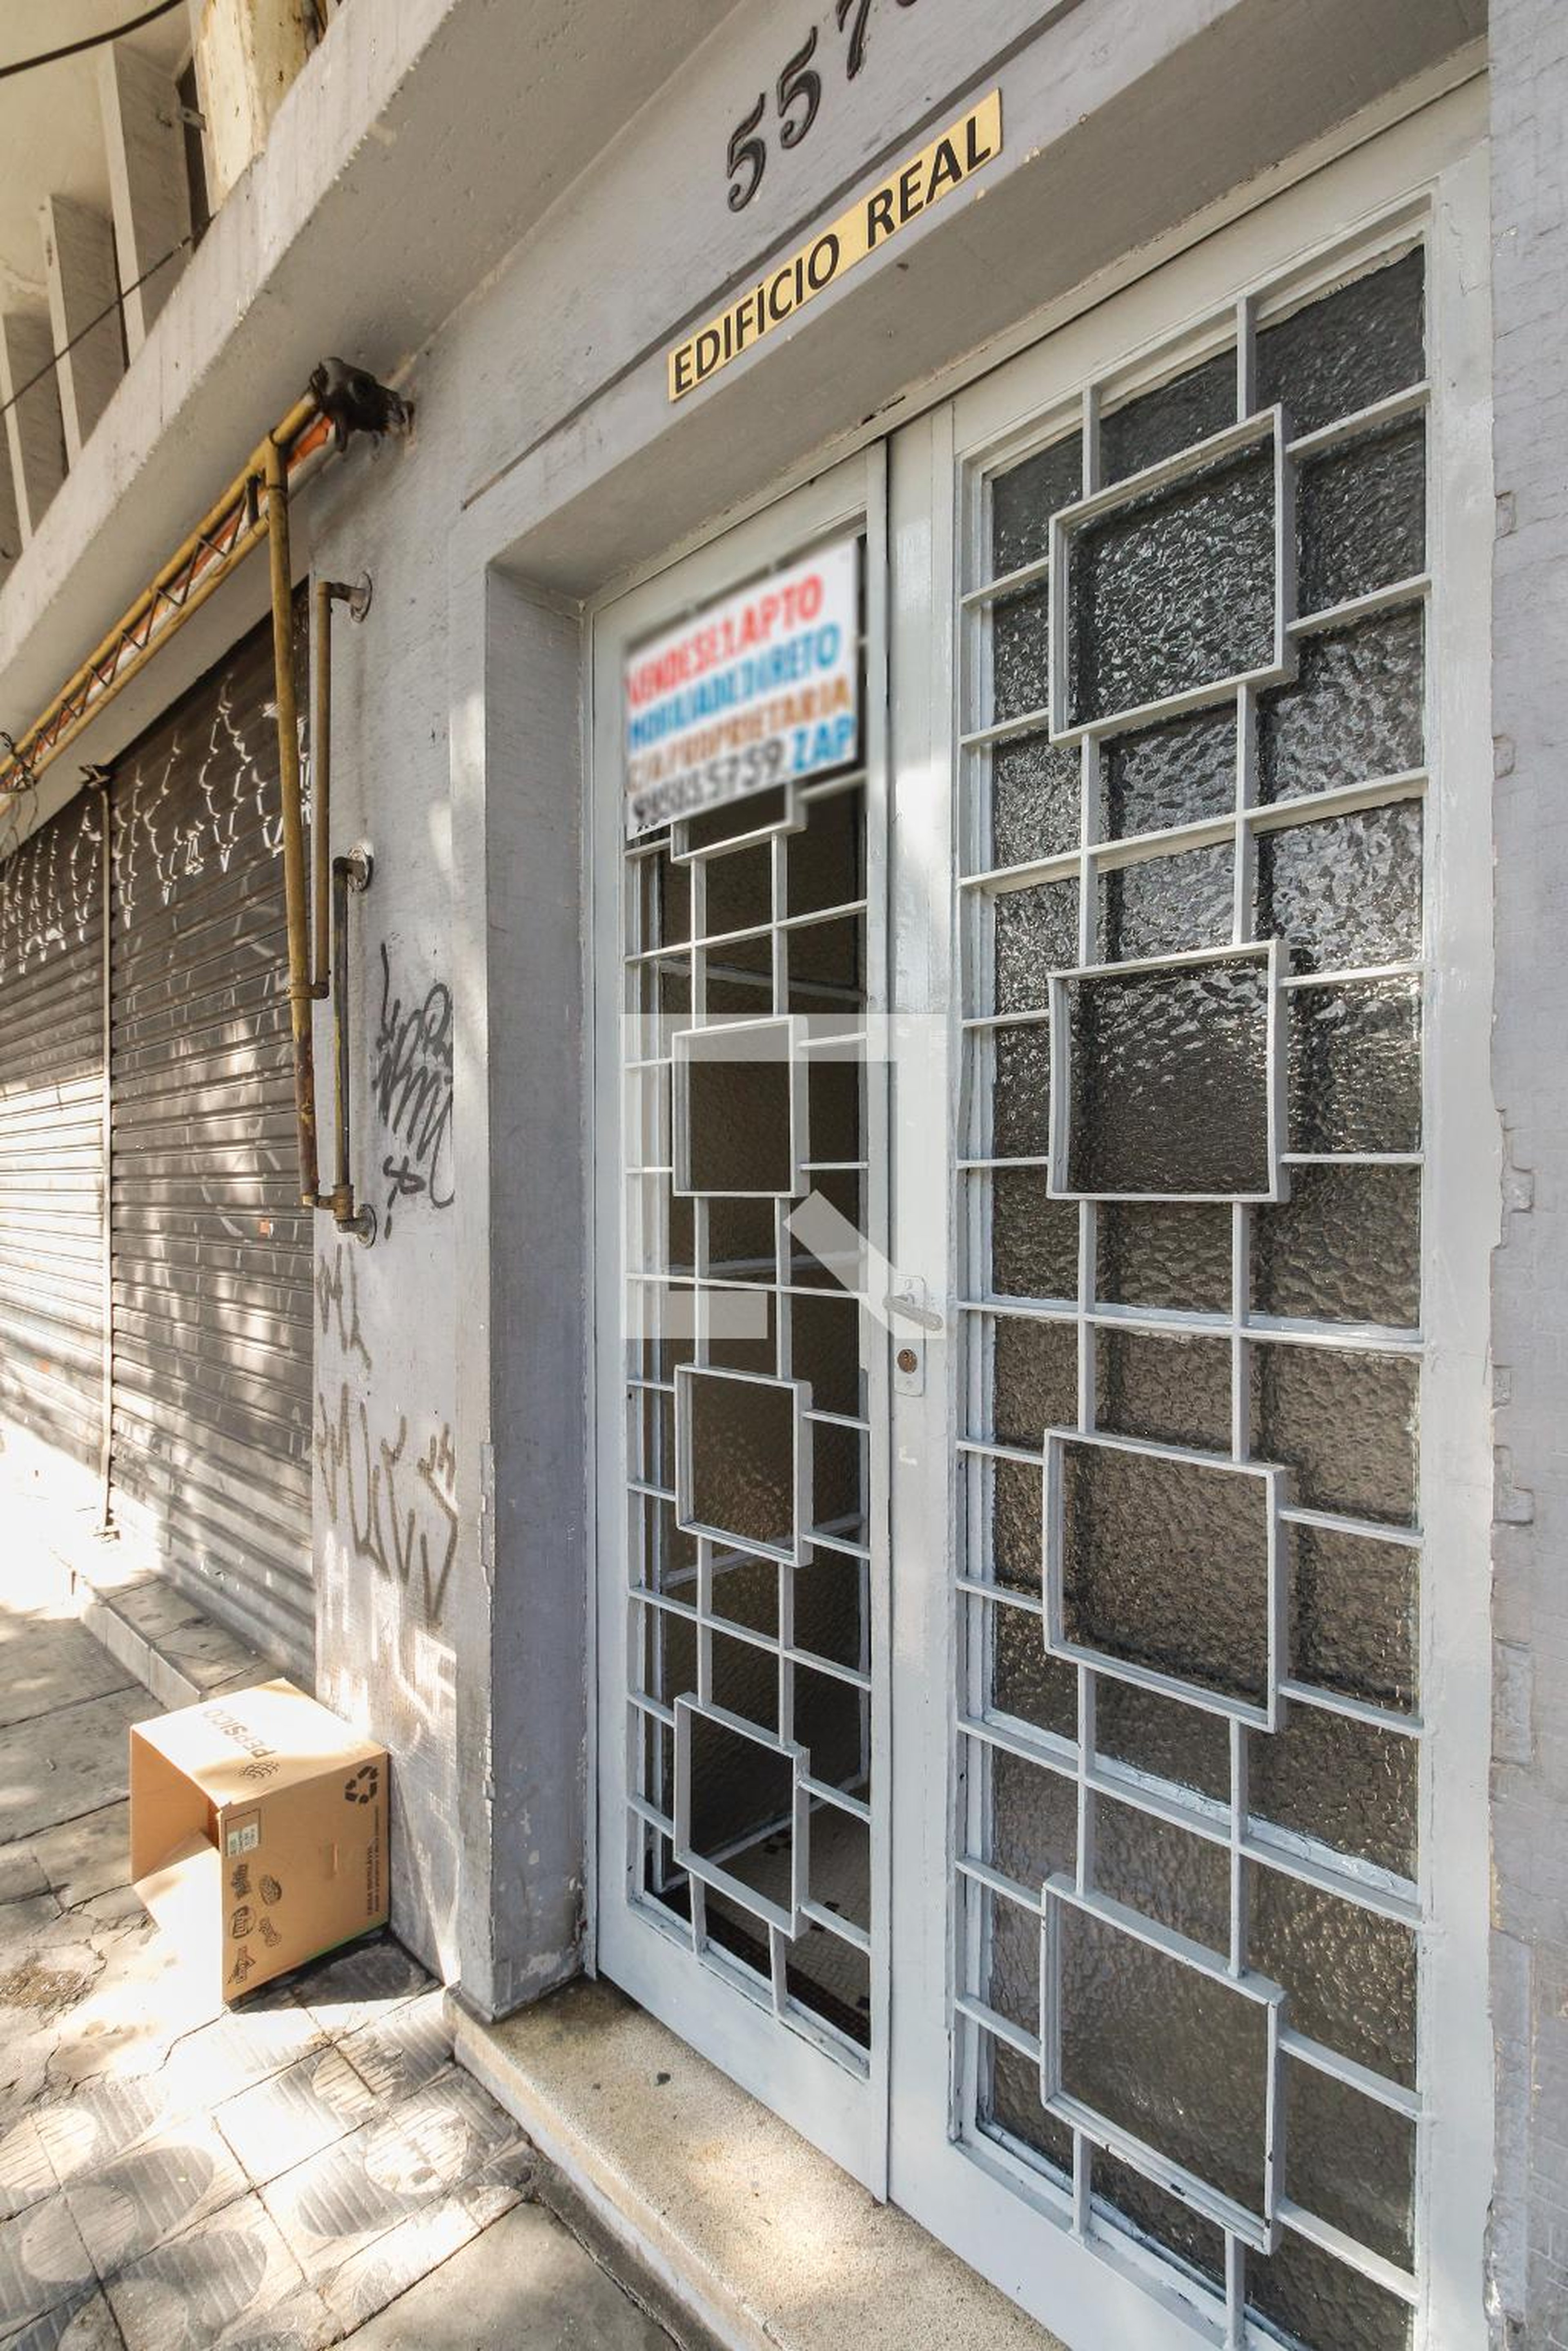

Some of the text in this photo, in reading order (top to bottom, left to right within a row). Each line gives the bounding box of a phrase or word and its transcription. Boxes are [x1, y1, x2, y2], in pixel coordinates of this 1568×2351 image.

[727, 0, 917, 212] 557
[675, 116, 991, 394] EDIFÍCIO REAL
